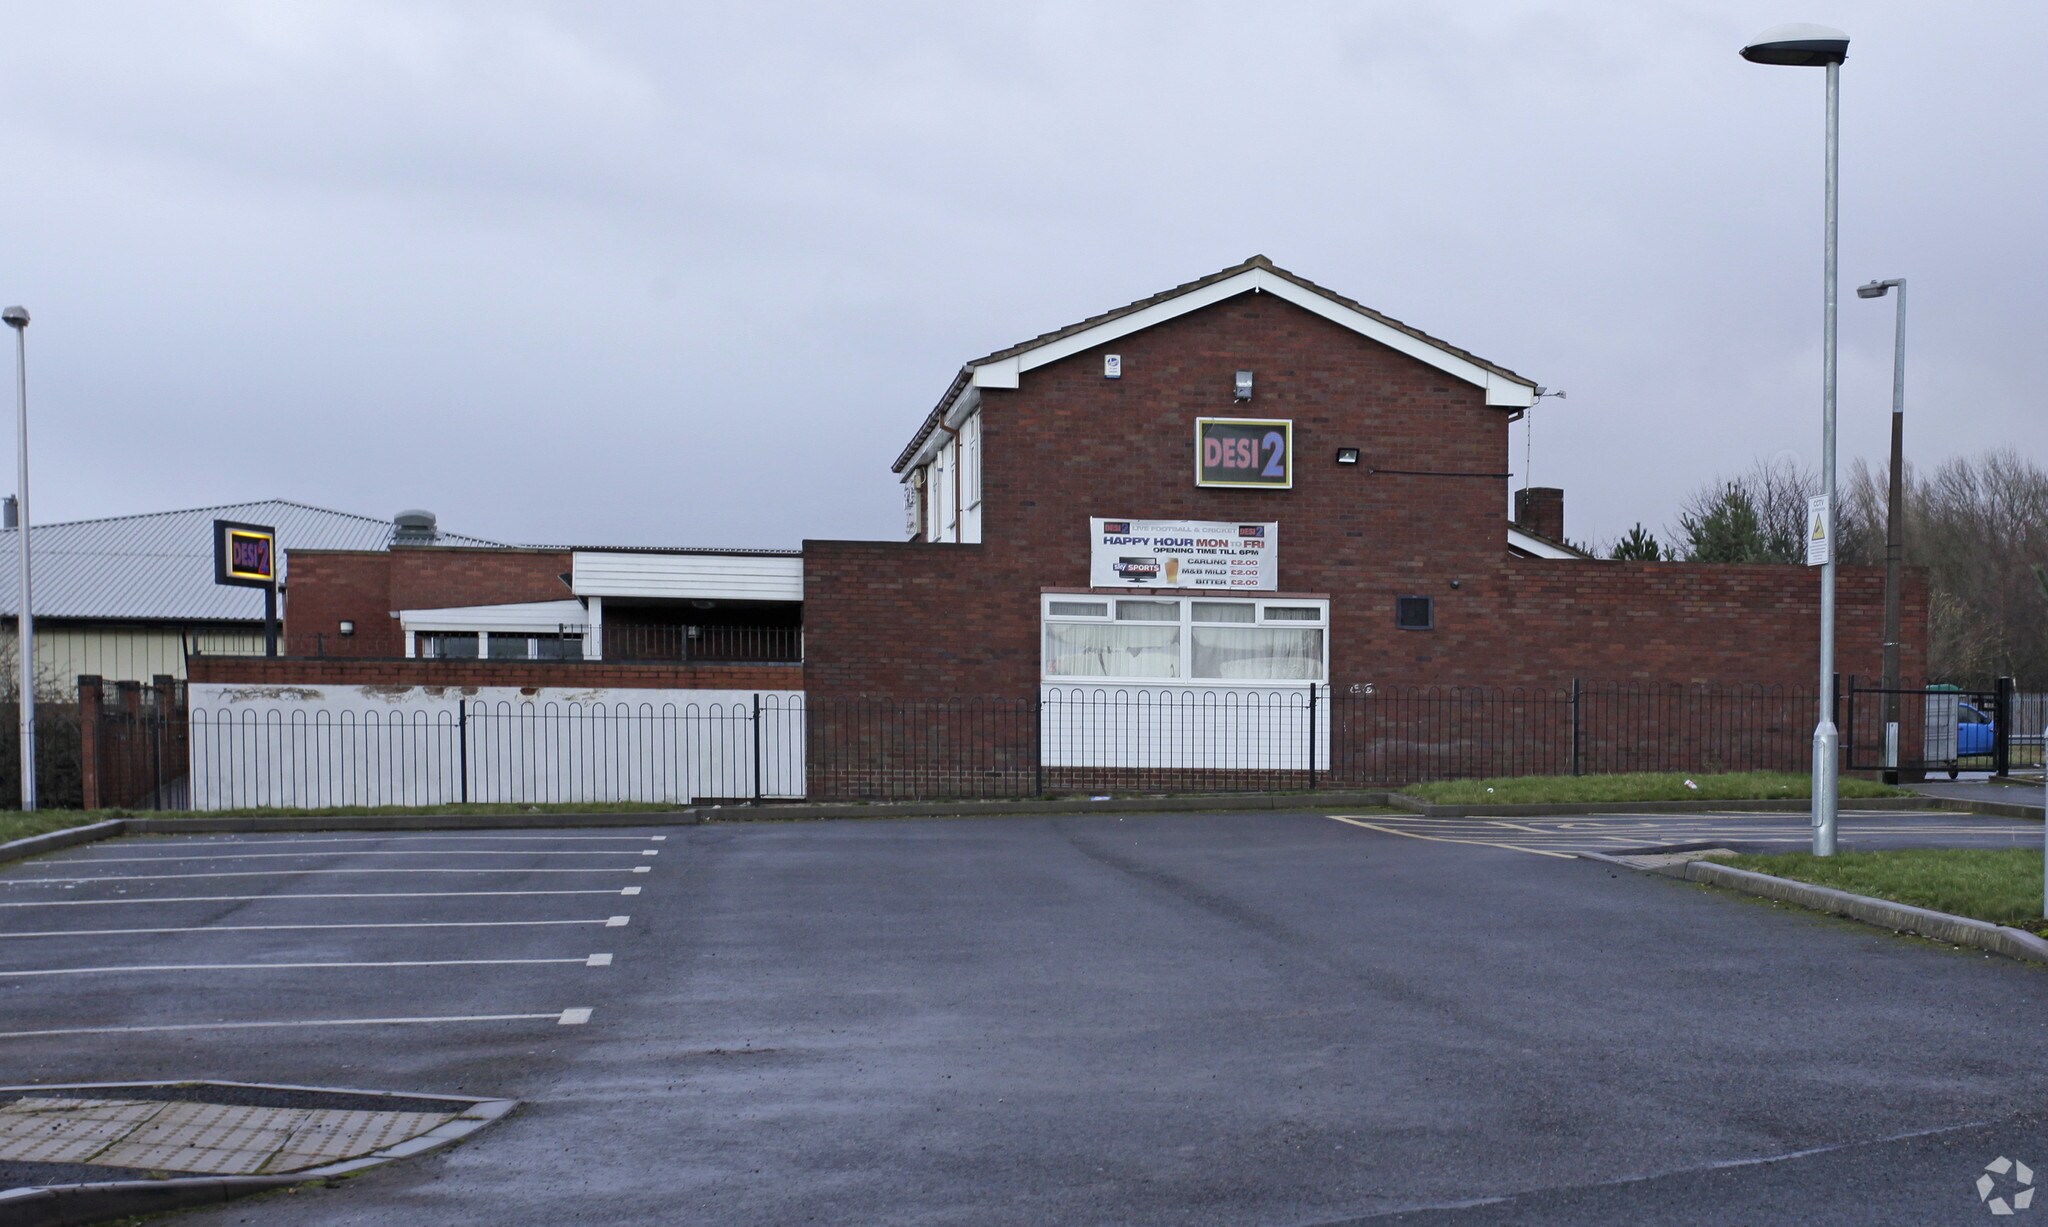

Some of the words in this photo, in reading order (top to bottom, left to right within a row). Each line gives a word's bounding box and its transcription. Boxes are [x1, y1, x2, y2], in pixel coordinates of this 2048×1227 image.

[1204, 437, 1259, 469] DESI
[1261, 431, 1285, 477] 2
[1104, 524, 1120, 533] DESI
[1121, 523, 1129, 533] 2
[1239, 528, 1255, 536] DESI
[1256, 527, 1263, 537] 2
[1104, 537, 1151, 546] HAPPY
[1153, 538, 1194, 547] HOUR
[1196, 539, 1229, 548] MON
[1243, 540, 1265, 549] FRI
[233, 542, 258, 567] DESI
[257, 540, 270, 574] 2
[1114, 563, 1127, 571] sky
[1128, 564, 1160, 572] SPORTS
